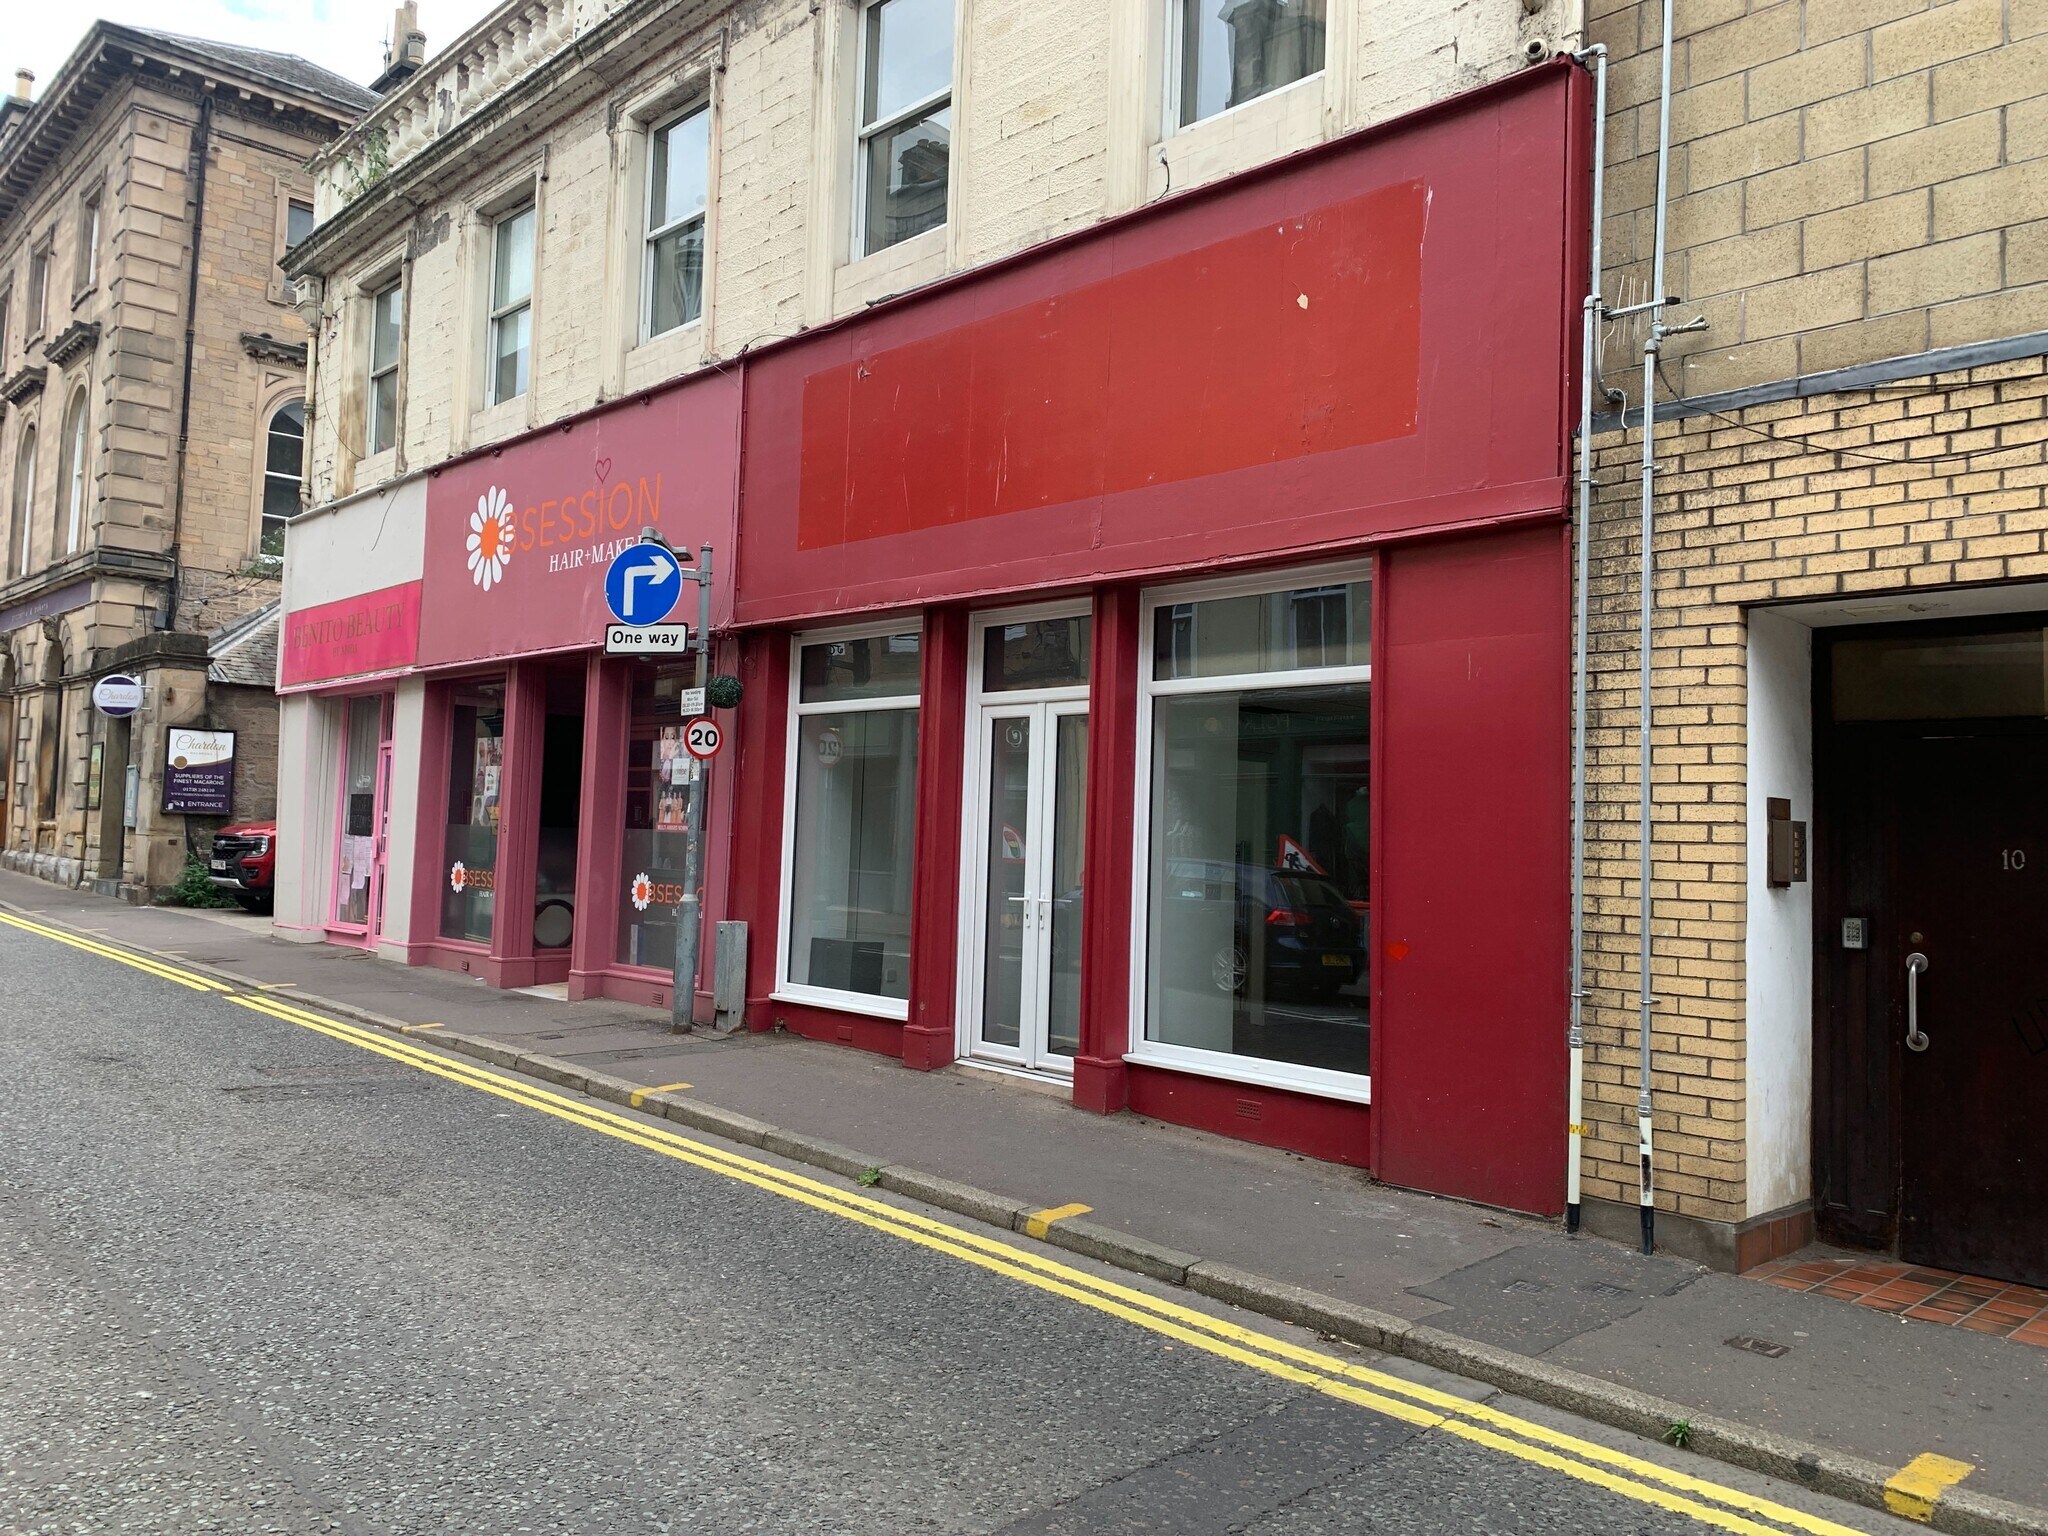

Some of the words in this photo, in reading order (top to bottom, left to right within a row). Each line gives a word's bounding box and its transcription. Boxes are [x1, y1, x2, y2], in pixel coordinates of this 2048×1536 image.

[293, 617, 343, 648] BENITO
[347, 602, 406, 639] BEAUTY
[612, 630, 642, 644] One
[648, 633, 679, 646] way
[176, 734, 226, 750] Chardon
[690, 728, 718, 747] 20
[2001, 849, 2026, 870] 10
